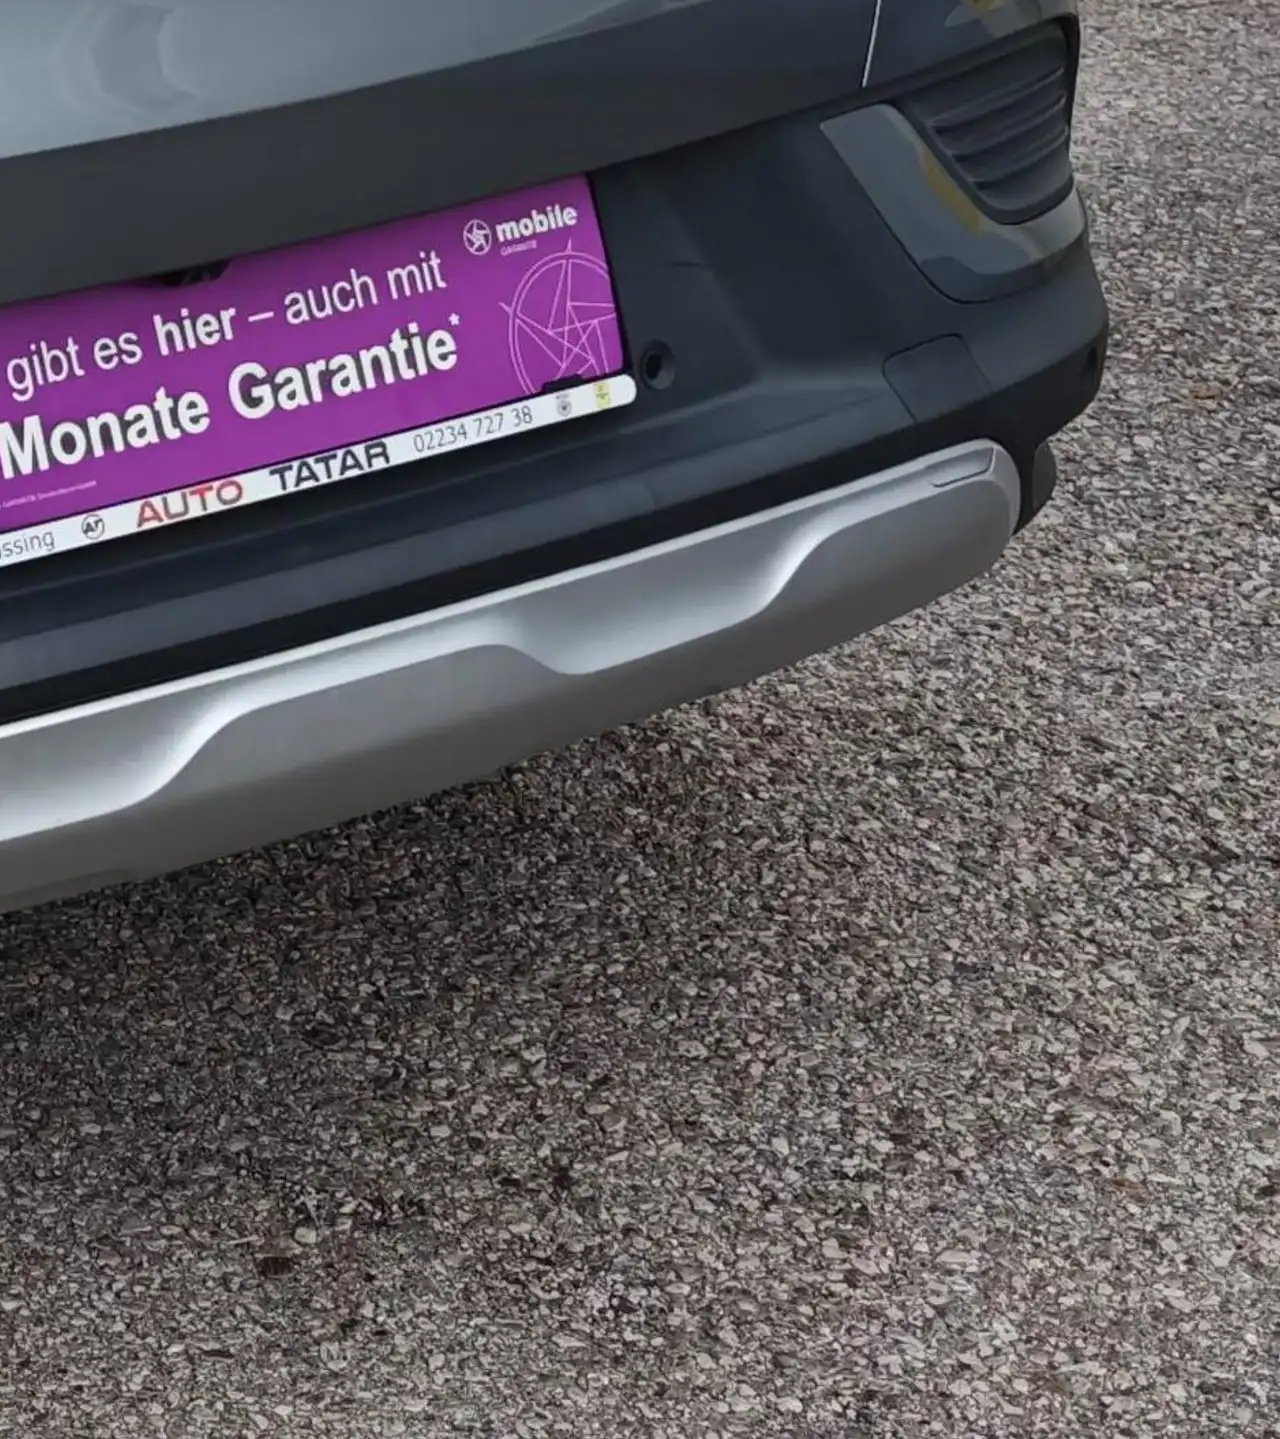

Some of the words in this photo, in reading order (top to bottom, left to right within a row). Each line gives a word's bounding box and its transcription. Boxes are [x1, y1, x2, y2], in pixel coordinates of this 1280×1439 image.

[495, 204, 578, 242] mobile
[6, 335, 85, 402] gibt
[93, 331, 143, 371] es
[152, 307, 236, 357] hier
[284, 268, 378, 325] auch
[387, 250, 448, 300] mit
[137, 480, 244, 528] AUTO
[269, 440, 391, 492] TATAR
[413, 422, 468, 453] 02234
[473, 412, 504, 435] 727
[512, 405, 534, 428] 38
